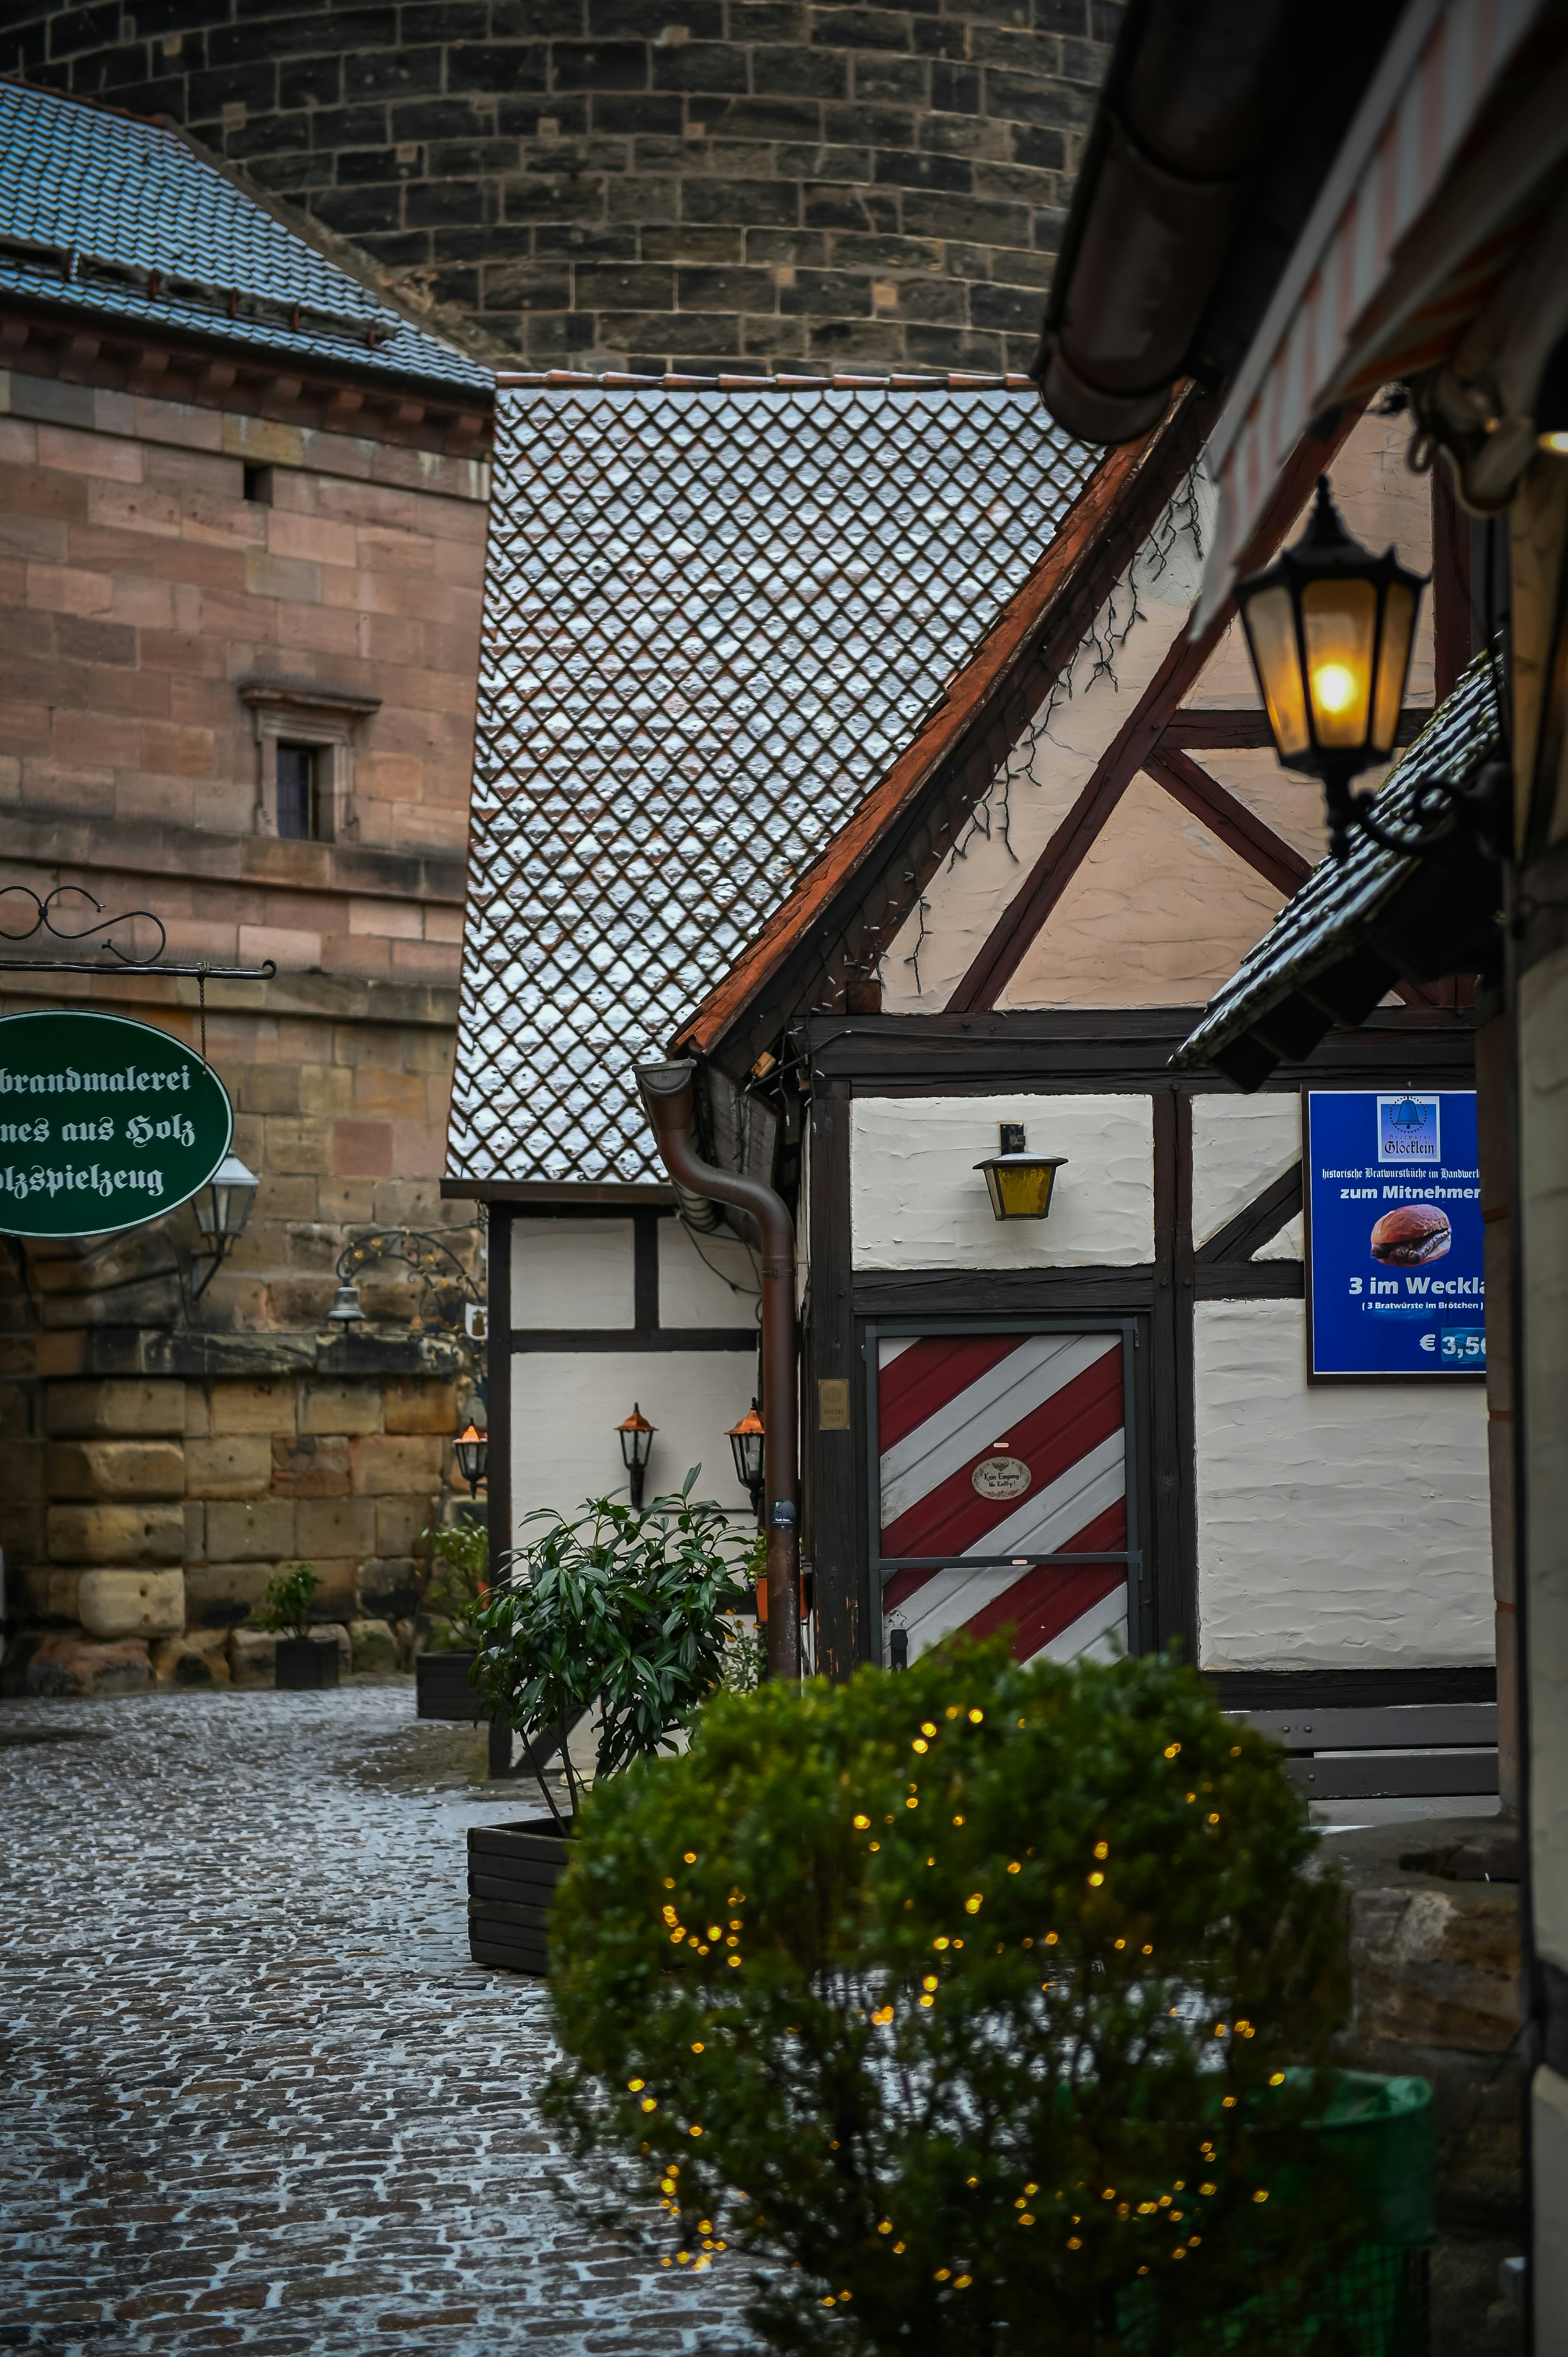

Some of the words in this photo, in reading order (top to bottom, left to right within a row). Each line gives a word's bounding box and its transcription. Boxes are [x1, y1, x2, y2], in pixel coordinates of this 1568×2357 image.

[62, 1117, 114, 1141] aus
[125, 1113, 195, 1147] Holz
[1384, 1140, 1435, 1157] Glöcklein
[0, 1164, 164, 1198] lzspielzeug
[1323, 1168, 1363, 1180] historische
[1365, 1168, 1426, 1179] Bratwurstküche
[1429, 1169, 1438, 1178] im
[1340, 1189, 1377, 1198] zum
[1349, 1277, 1362, 1294] 3
[1370, 1277, 1398, 1294] im
[1420, 1334, 1436, 1351] €
[984, 1472, 997, 1481] Kein
